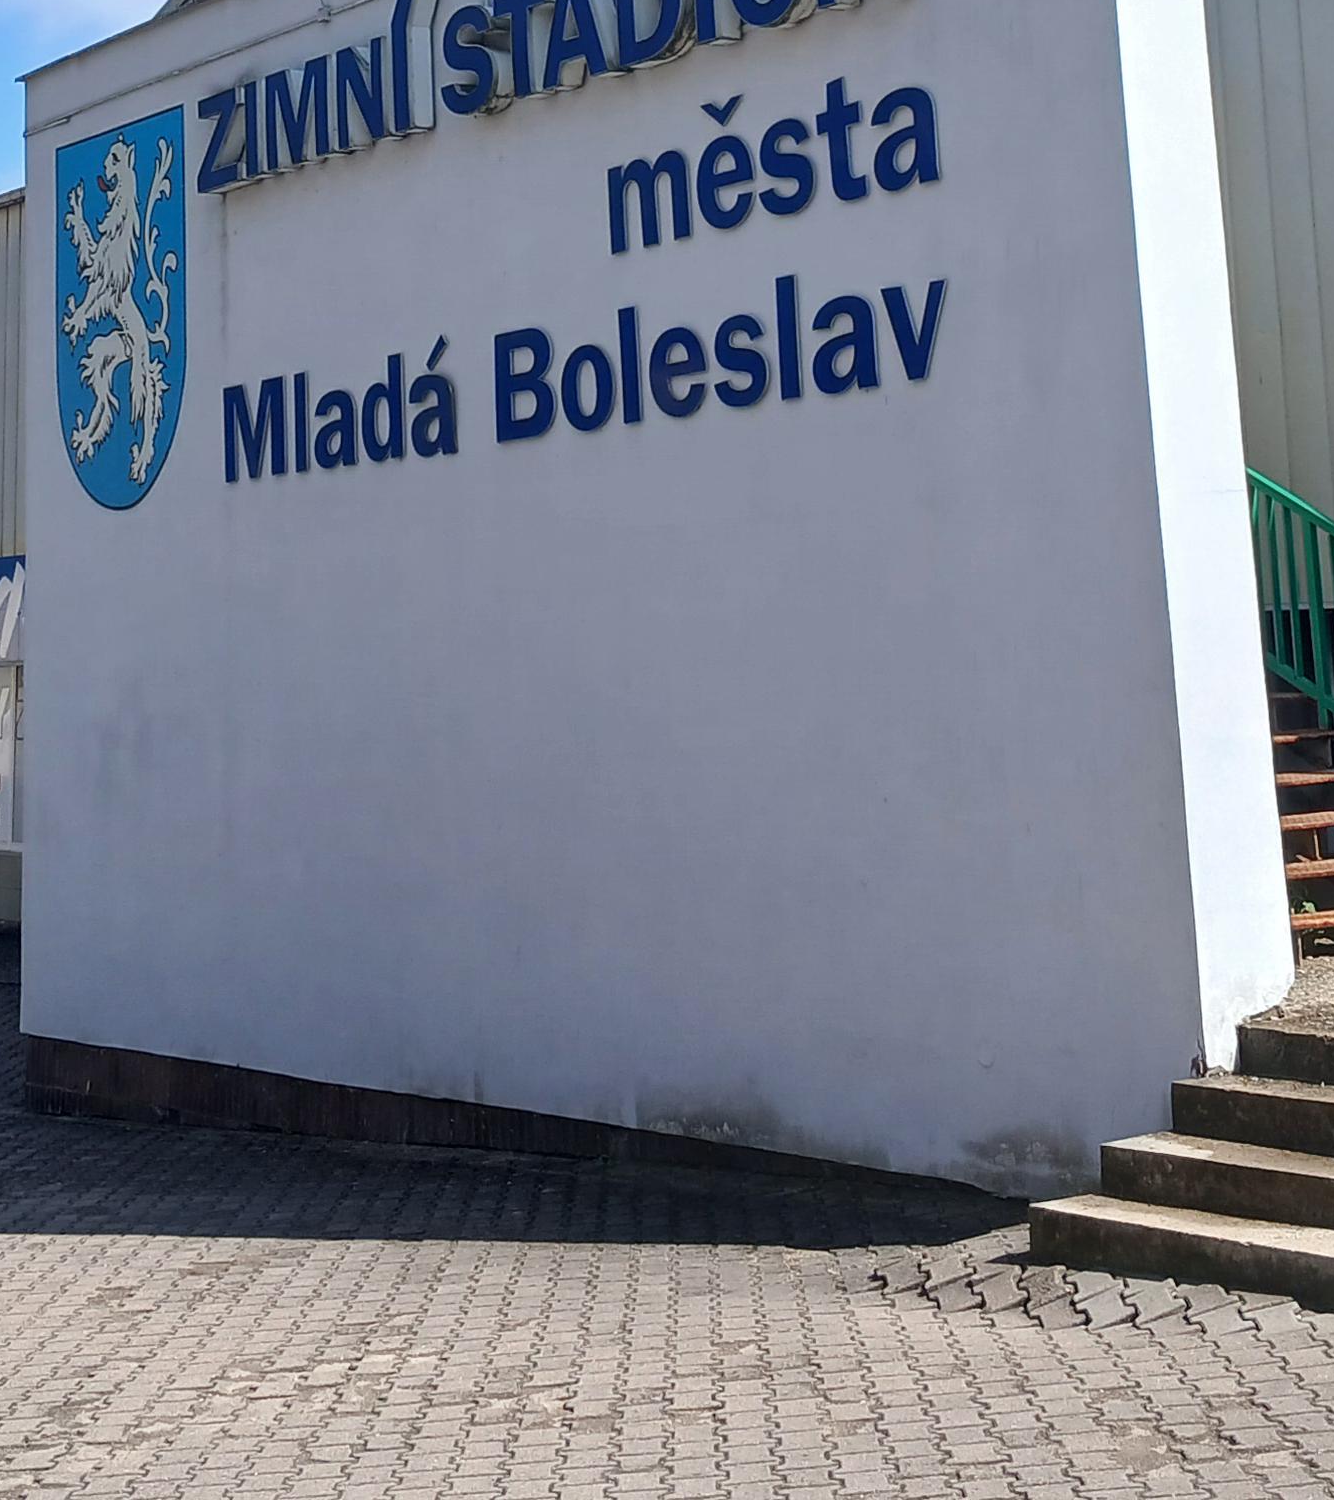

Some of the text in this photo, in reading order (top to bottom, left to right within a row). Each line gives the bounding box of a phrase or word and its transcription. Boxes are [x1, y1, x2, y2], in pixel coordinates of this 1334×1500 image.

[608, 75, 941, 255] města
[223, 274, 947, 483] Mladá Boleslav
